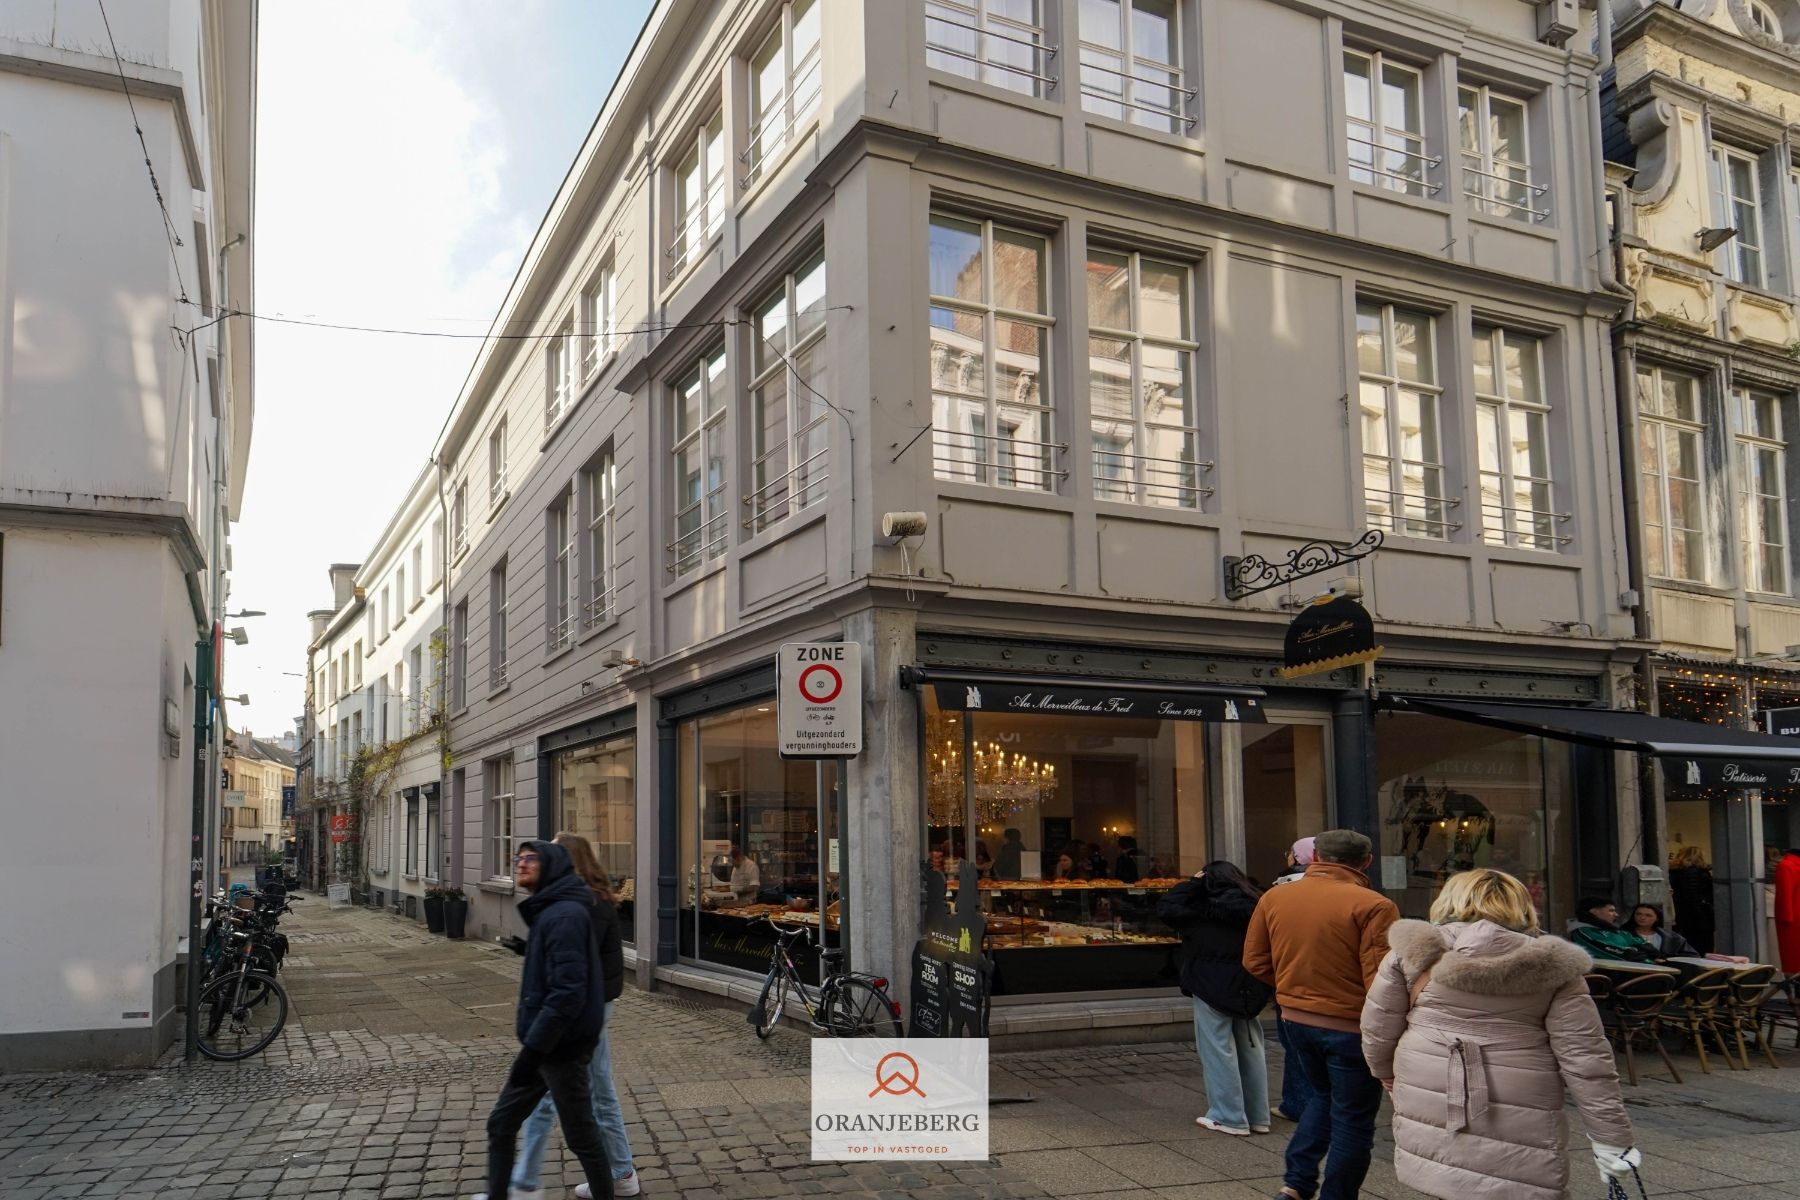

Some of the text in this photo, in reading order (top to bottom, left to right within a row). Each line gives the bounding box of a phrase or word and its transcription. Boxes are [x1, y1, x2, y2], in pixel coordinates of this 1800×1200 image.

[797, 647, 845, 661] ZONE
[1032, 694, 1091, 711] Merveilleux
[1091, 700, 1103, 712] de
[1104, 697, 1134, 713] Fred
[1157, 700, 1182, 715] Since
[796, 730, 845, 740] Uitgezonderd
[785, 741, 857, 752] vergunninghouders
[1722, 763, 1768, 783] Patisserie
[932, 932, 959, 944] WELCOME
[923, 964, 936, 975] TEA
[922, 972, 938, 984] ROOM
[955, 971, 975, 986] SHOP
